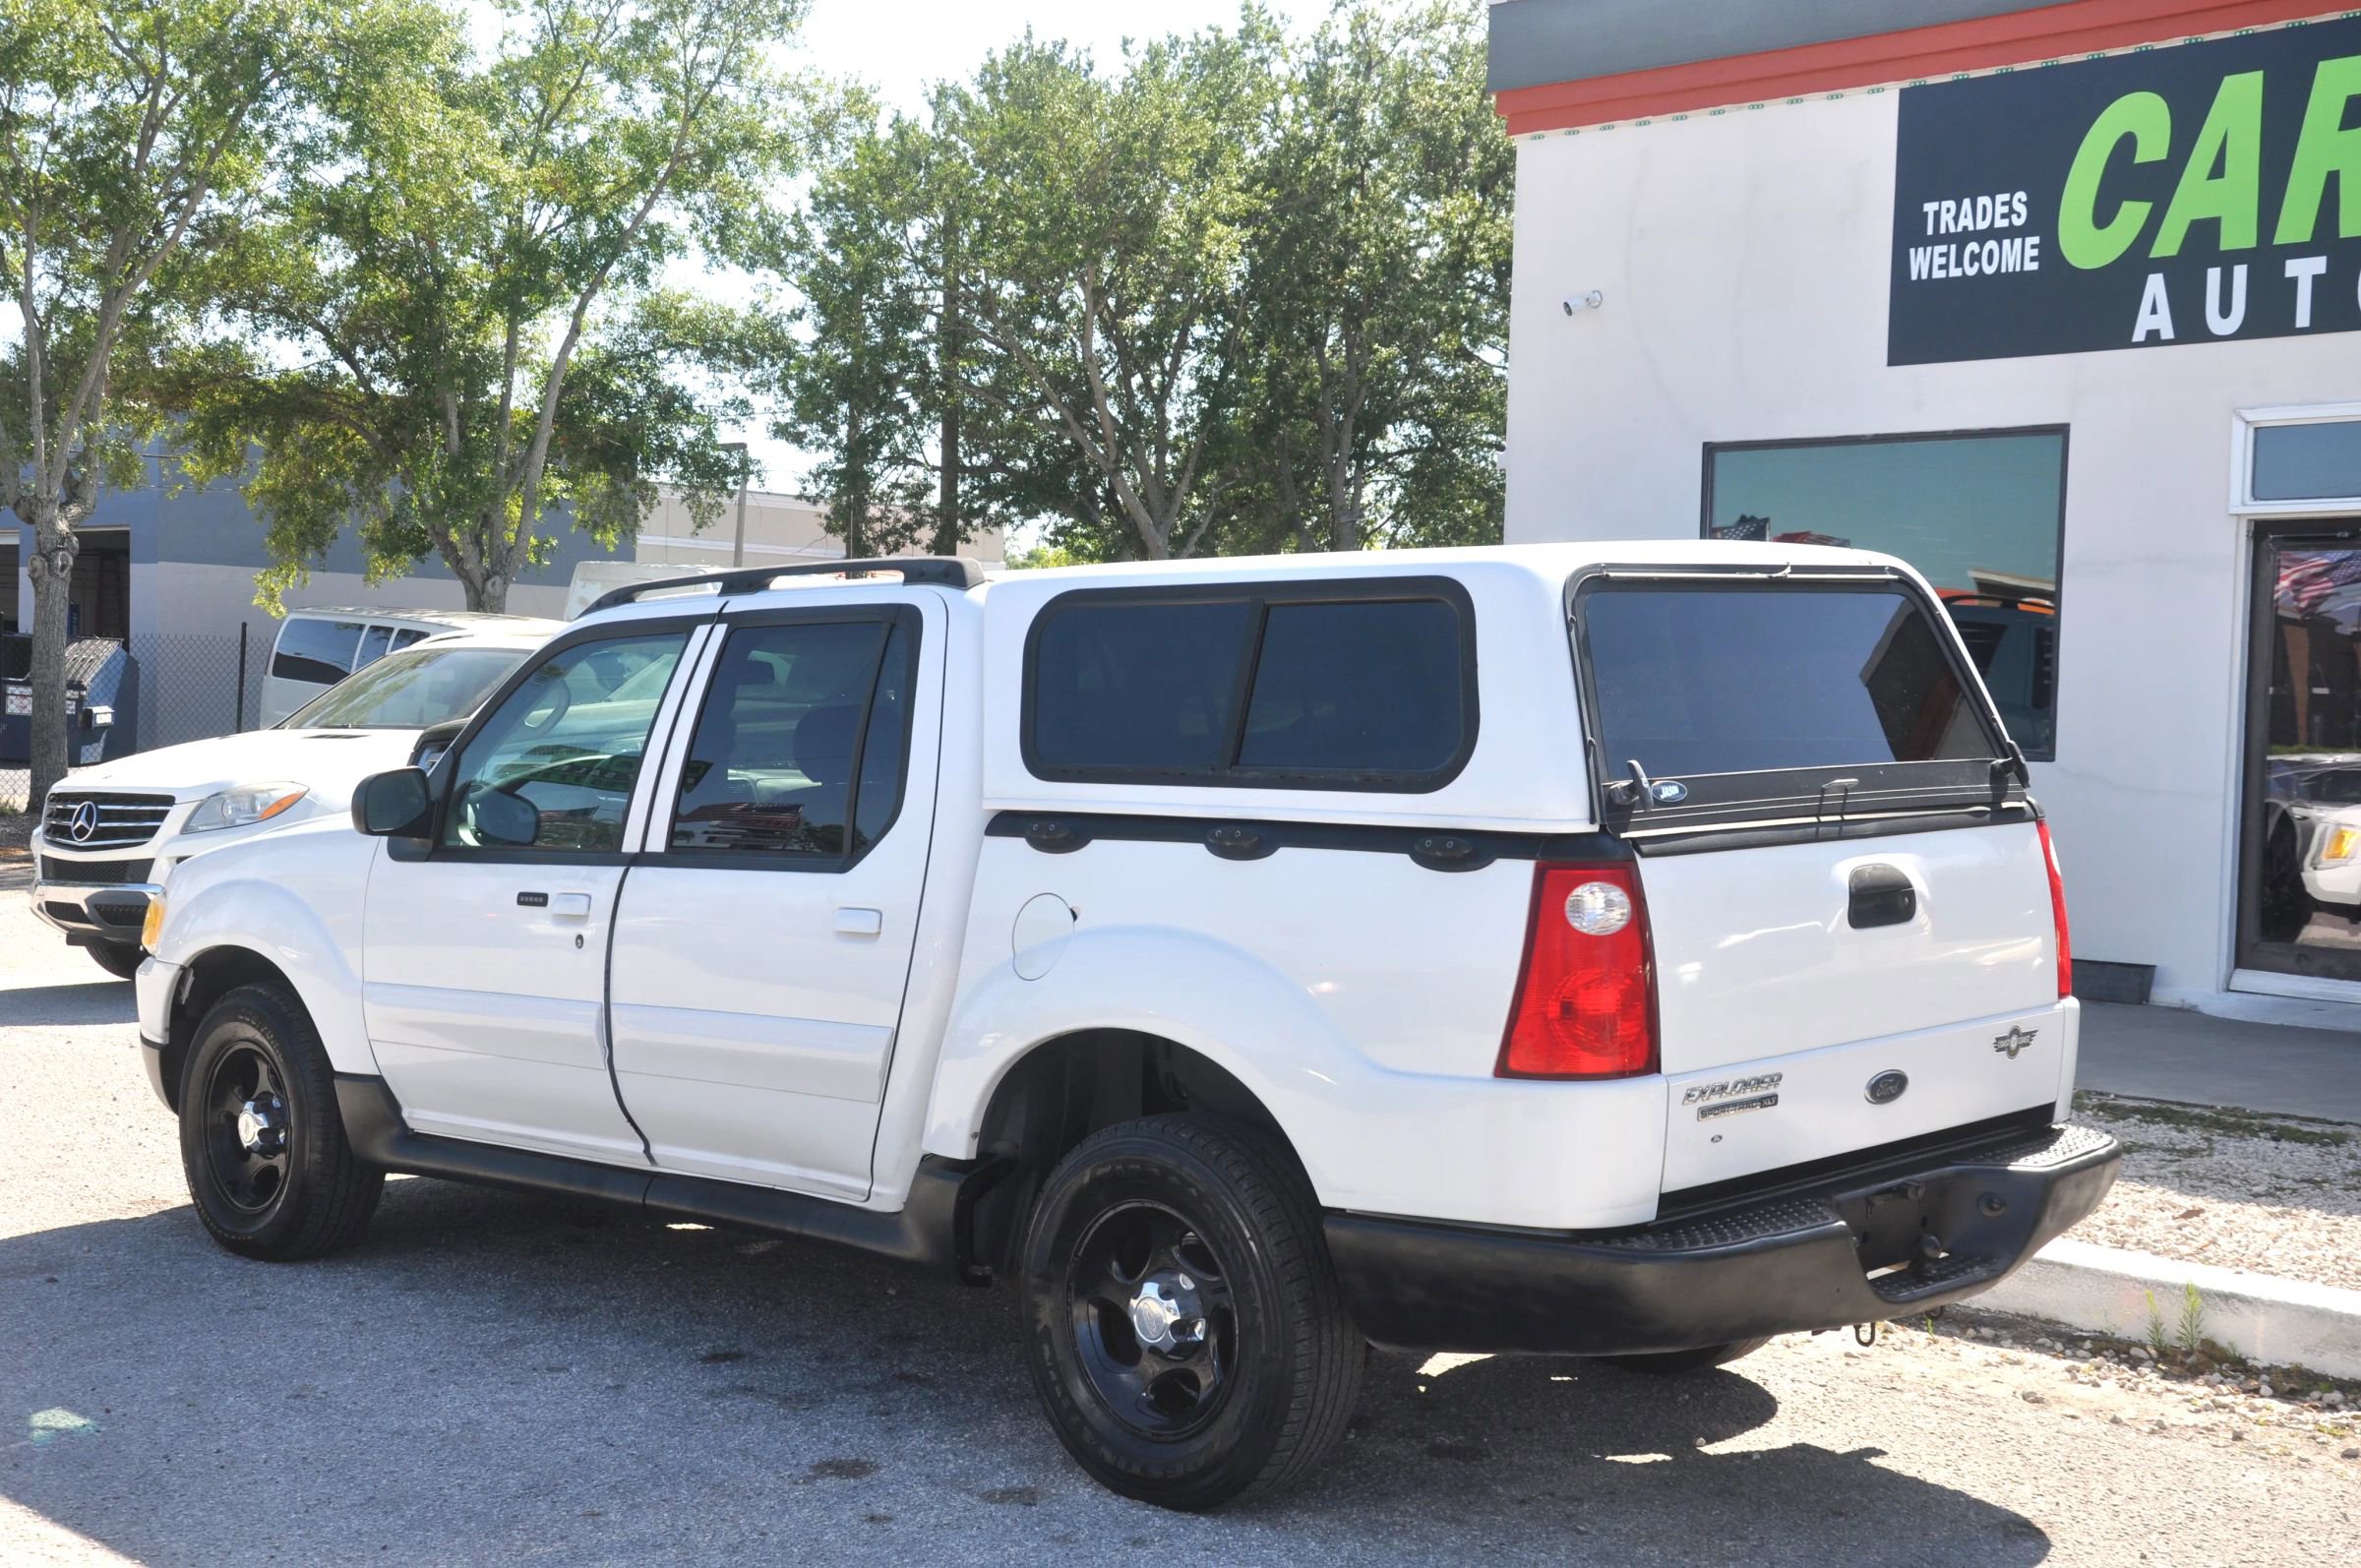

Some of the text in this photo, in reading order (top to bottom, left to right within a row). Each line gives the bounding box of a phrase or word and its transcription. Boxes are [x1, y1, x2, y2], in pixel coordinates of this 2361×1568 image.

[1922, 190, 2028, 236] TRADES
[1908, 235, 2040, 281] WELCOME
[2131, 255, 2361, 343] AUT
[1681, 1071, 1784, 1106] EXPLORER
